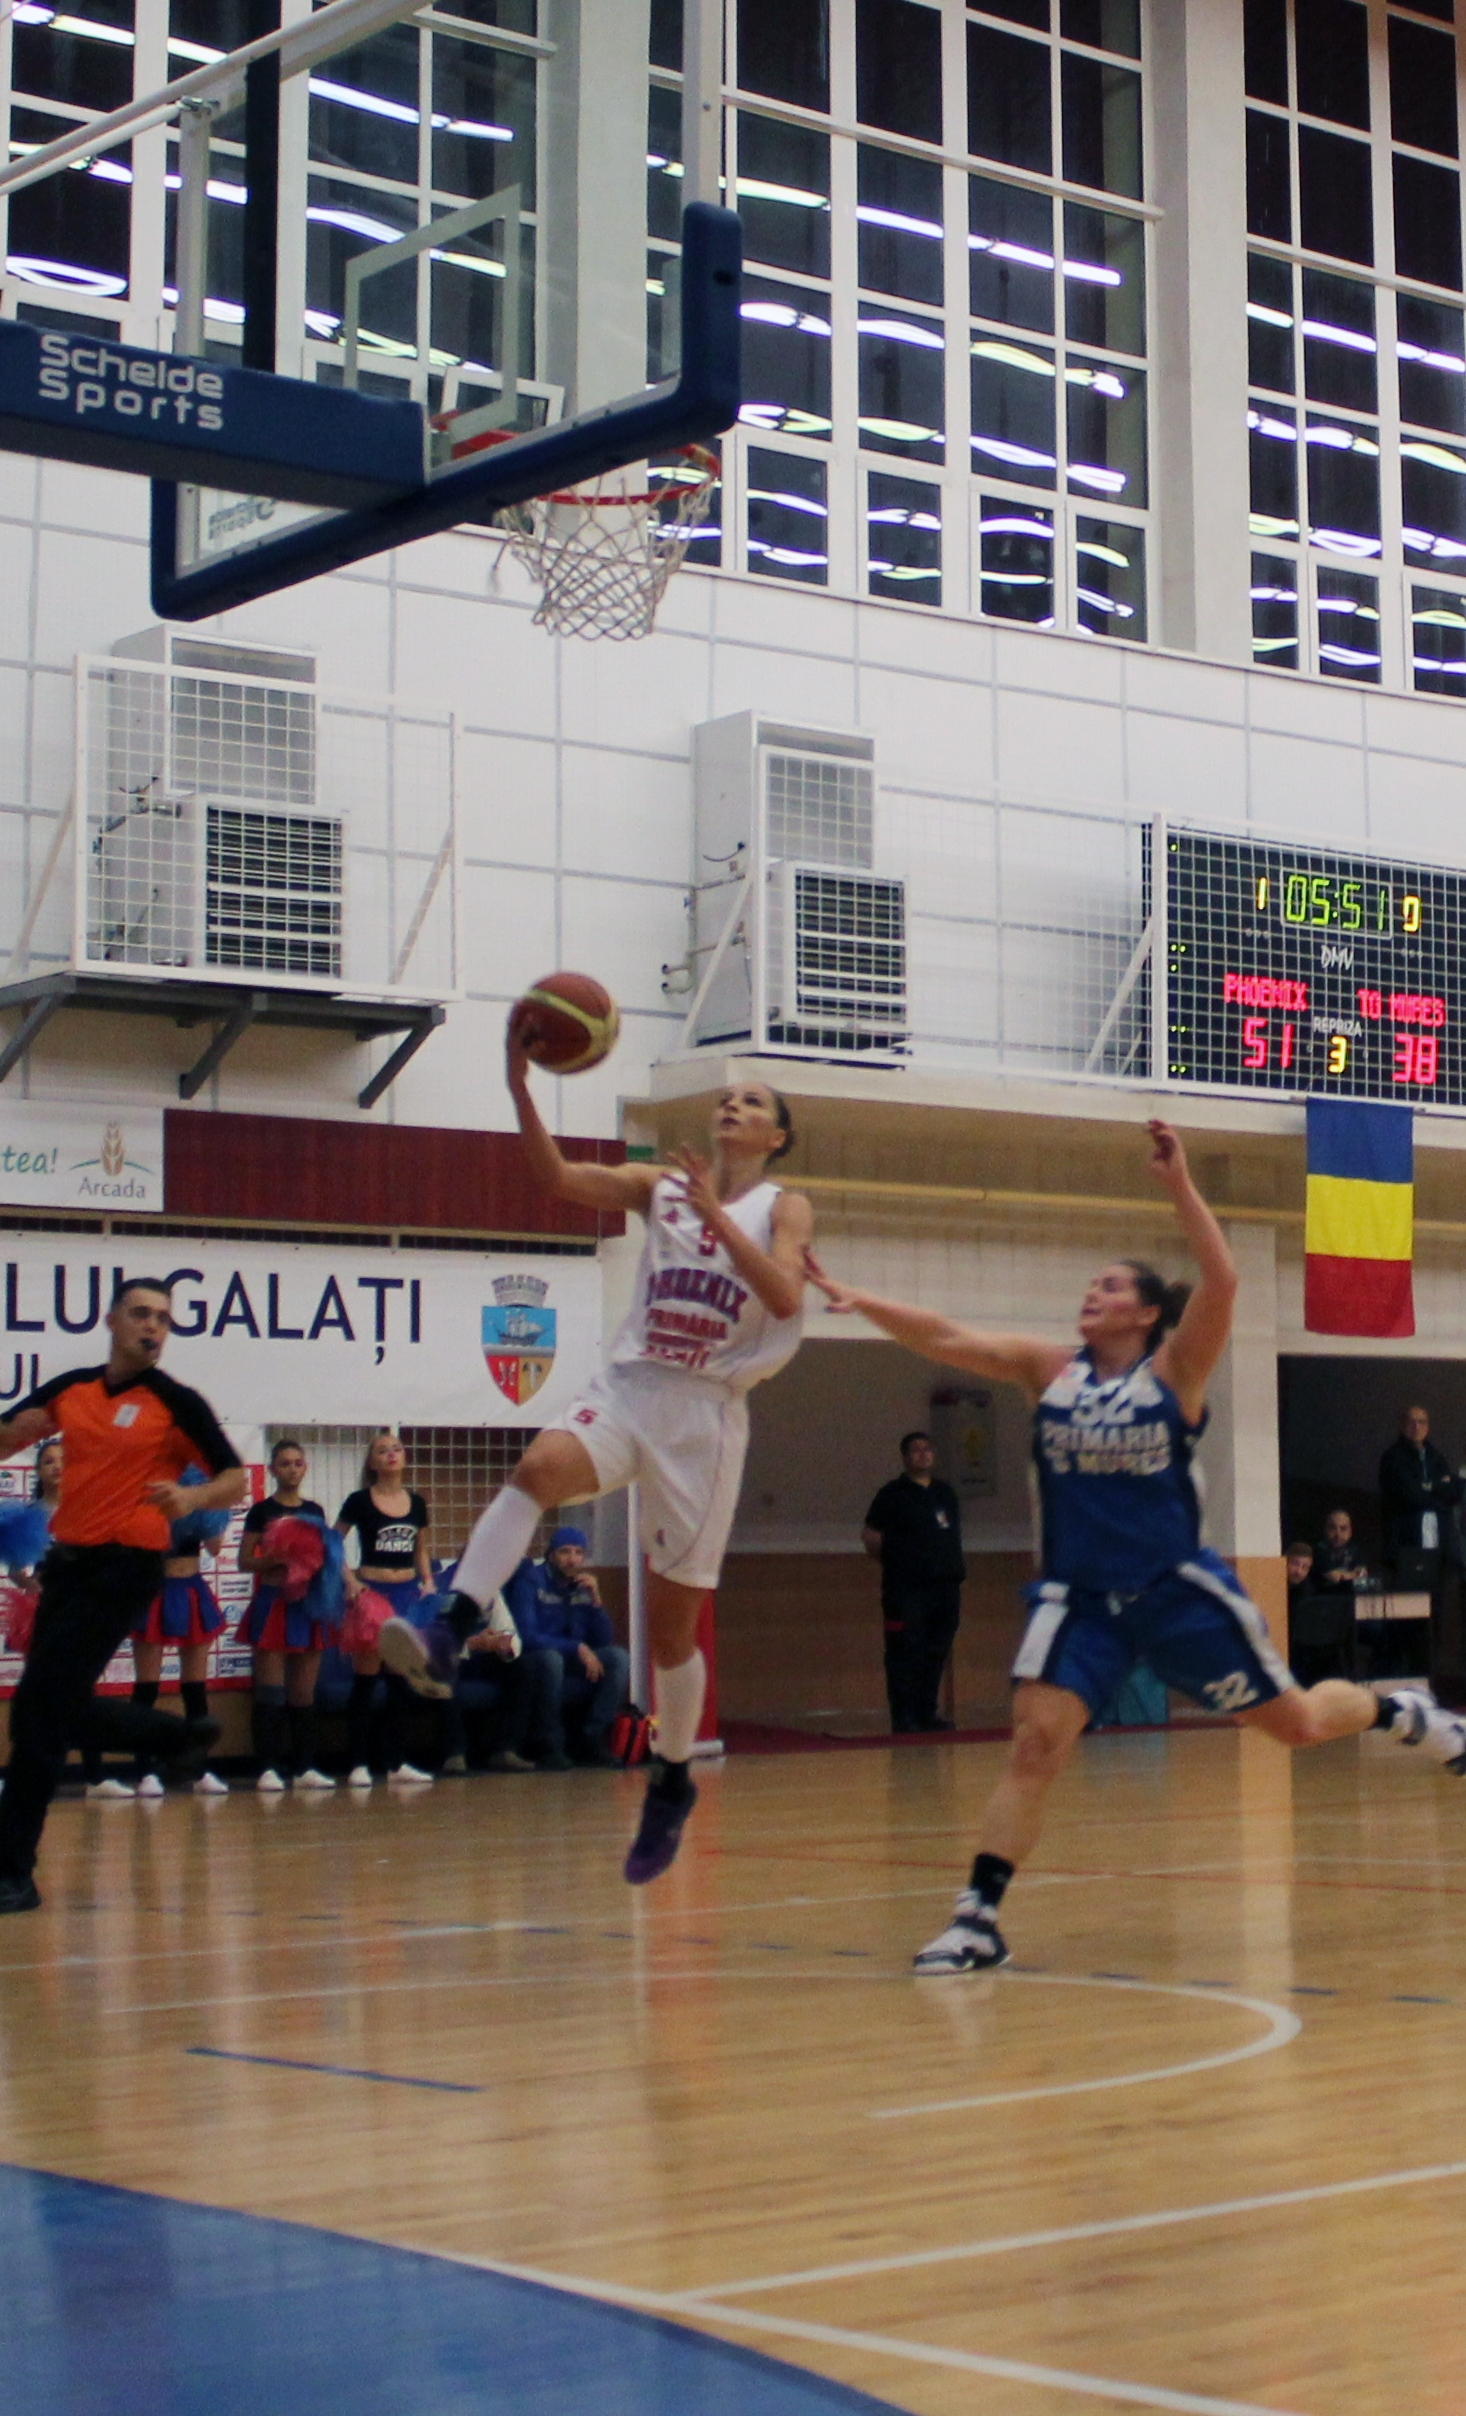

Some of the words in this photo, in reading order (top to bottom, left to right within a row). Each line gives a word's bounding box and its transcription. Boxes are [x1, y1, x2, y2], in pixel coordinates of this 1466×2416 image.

[39, 333, 224, 400] Schelde
[38, 367, 224, 431] Sports
[1286, 875, 1386, 931] 05:51
[1223, 972, 1310, 1012] PHOENIX
[1244, 1016, 1294, 1068] 51
[1392, 1032, 1438, 1084] 38
[1313, 1015, 1362, 1038] REPRIZA
[1327, 1035, 1348, 1074] 3
[1, 1145, 58, 1174] tea!
[78, 1177, 147, 1199] Arcada
[6, 1262, 123, 1334] LU
